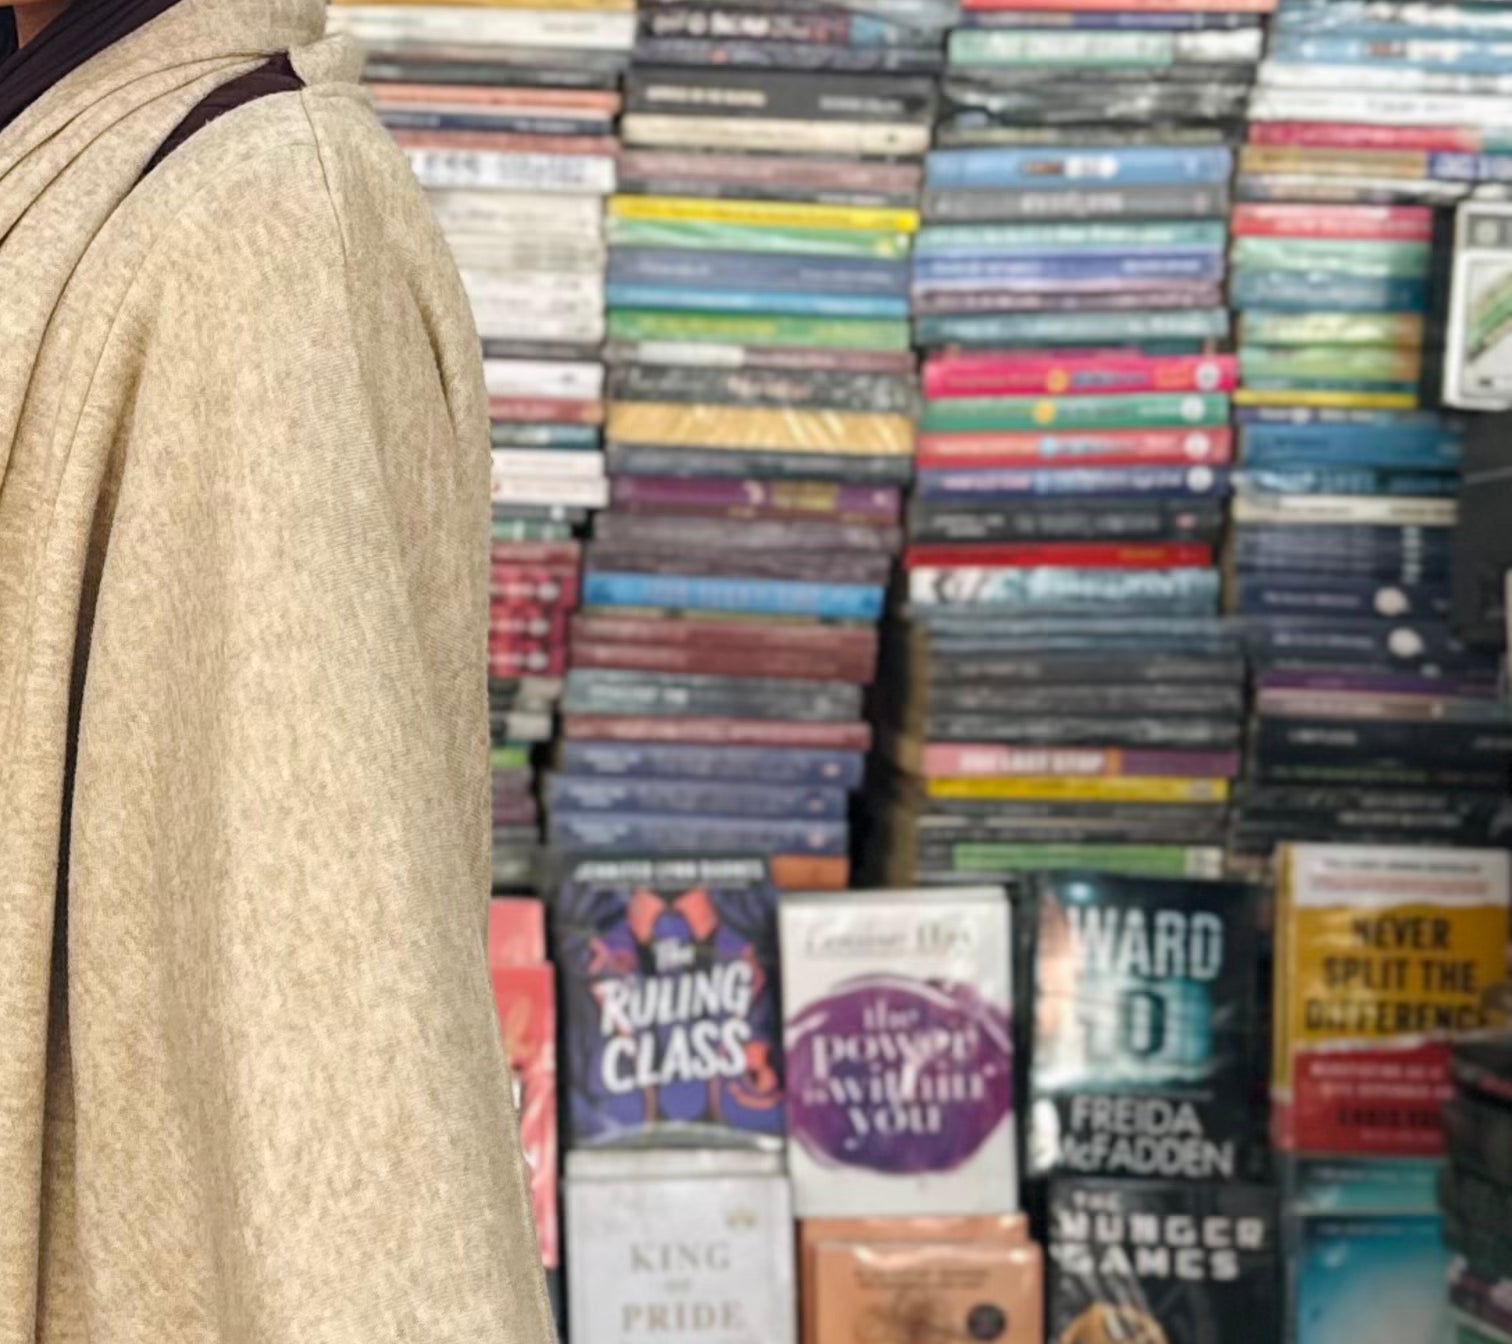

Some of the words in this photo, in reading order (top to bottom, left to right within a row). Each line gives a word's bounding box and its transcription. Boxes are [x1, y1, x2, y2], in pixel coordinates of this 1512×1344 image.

[1070, 908, 1225, 979] WARD
[1352, 916, 1451, 951] NEVER
[654, 937, 696, 972] The
[1323, 955, 1408, 990] SPLIT
[1421, 959, 1479, 993] THE
[599, 959, 754, 1035] RULING
[862, 998, 920, 1030] the
[600, 1018, 753, 1094] CLASS
[810, 1025, 979, 1080] power
[844, 1104, 942, 1151] you
[1070, 1095, 1204, 1139] FREIDA
[1072, 1190, 1122, 1215] THE
[1058, 1213, 1266, 1250] HUNGER
[629, 1242, 731, 1271] KING
[622, 1301, 747, 1334] PRIDE
